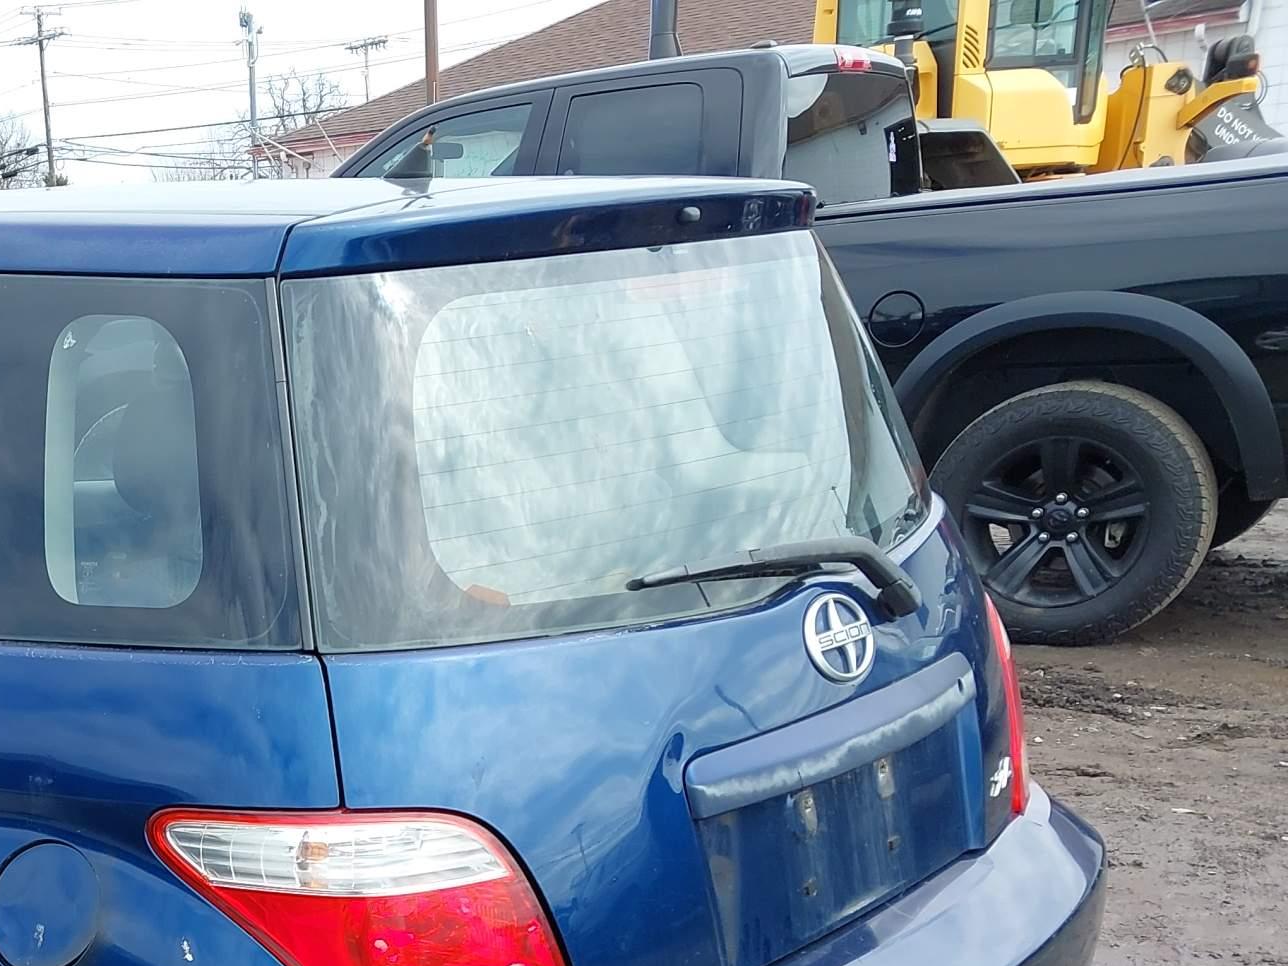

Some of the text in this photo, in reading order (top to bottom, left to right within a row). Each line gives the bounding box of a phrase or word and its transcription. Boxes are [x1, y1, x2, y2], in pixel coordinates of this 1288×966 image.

[1217, 107, 1233, 123] DO
[1231, 118, 1253, 139] NOT
[818, 622, 871, 649] SCION
